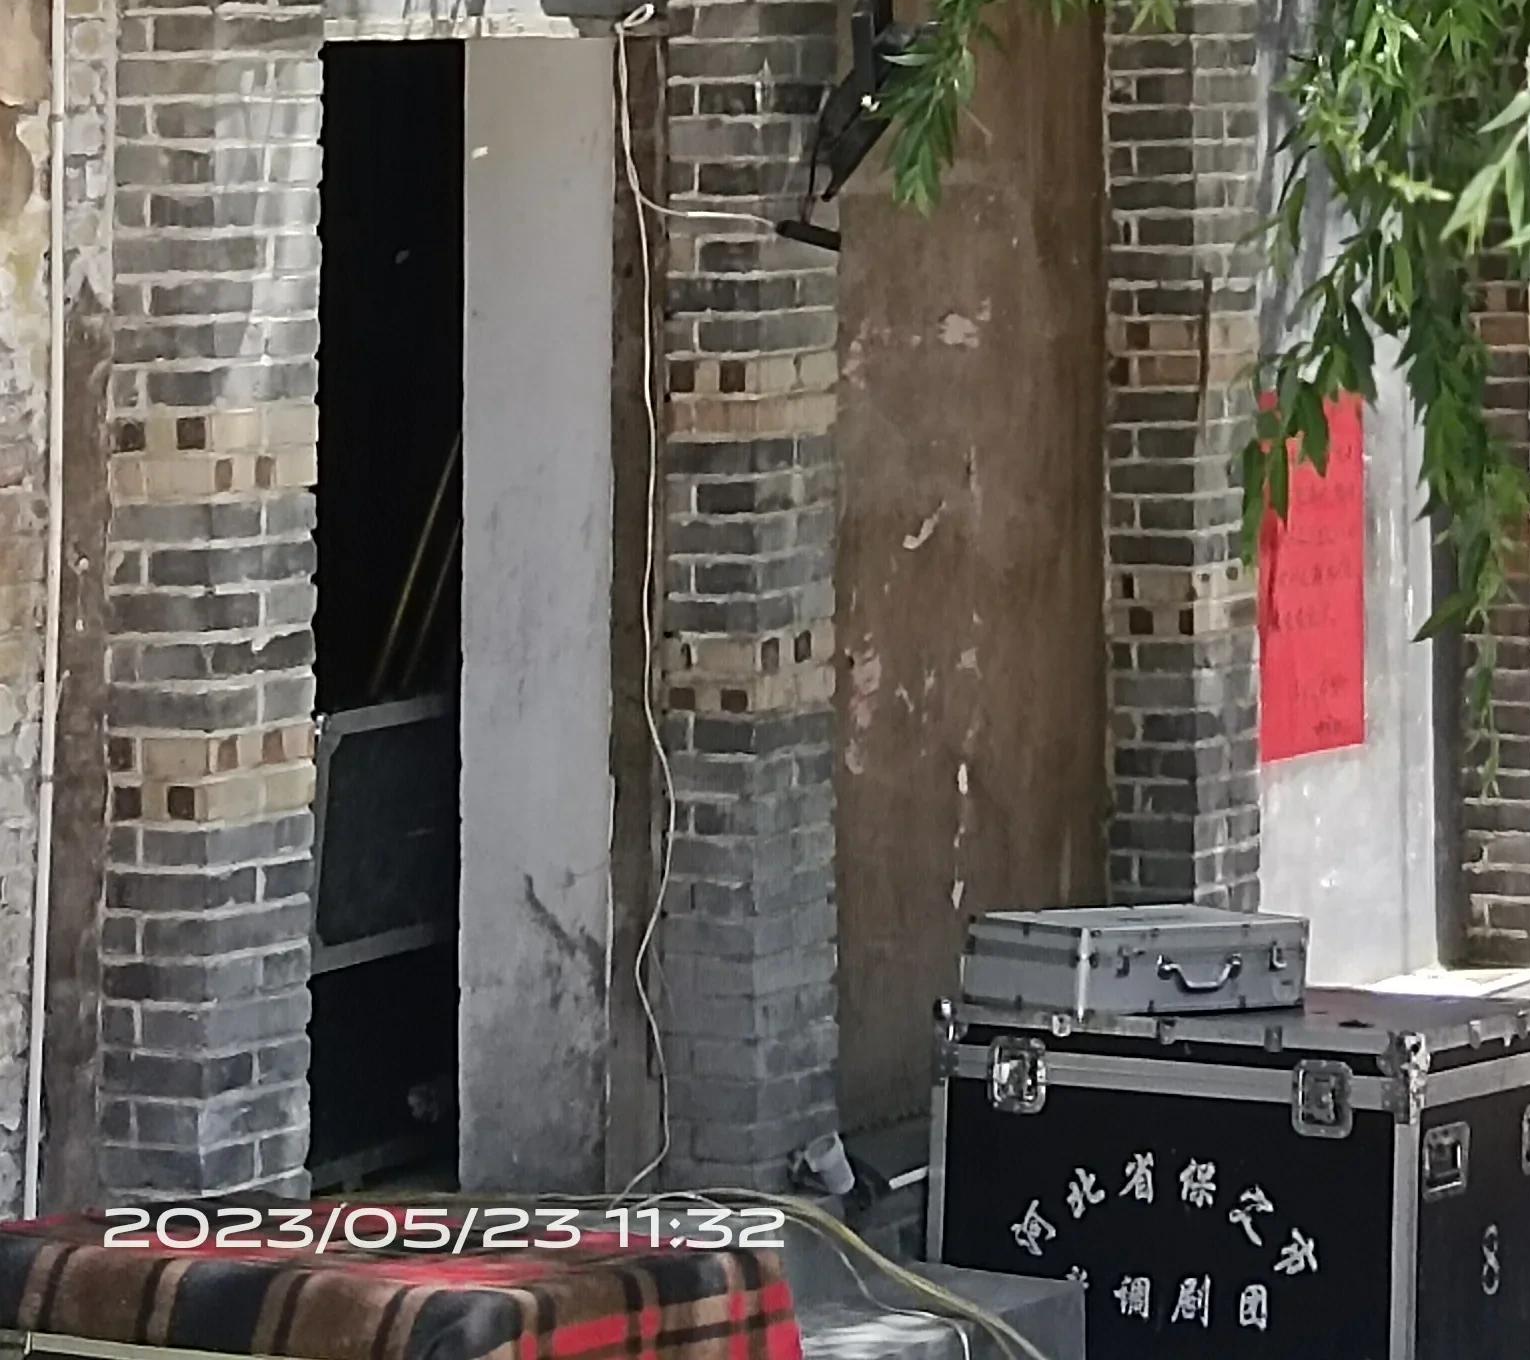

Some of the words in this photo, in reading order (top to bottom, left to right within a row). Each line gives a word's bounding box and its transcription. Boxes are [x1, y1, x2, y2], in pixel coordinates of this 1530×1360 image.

[1010, 1151, 1319, 1276] 河北省保定市
